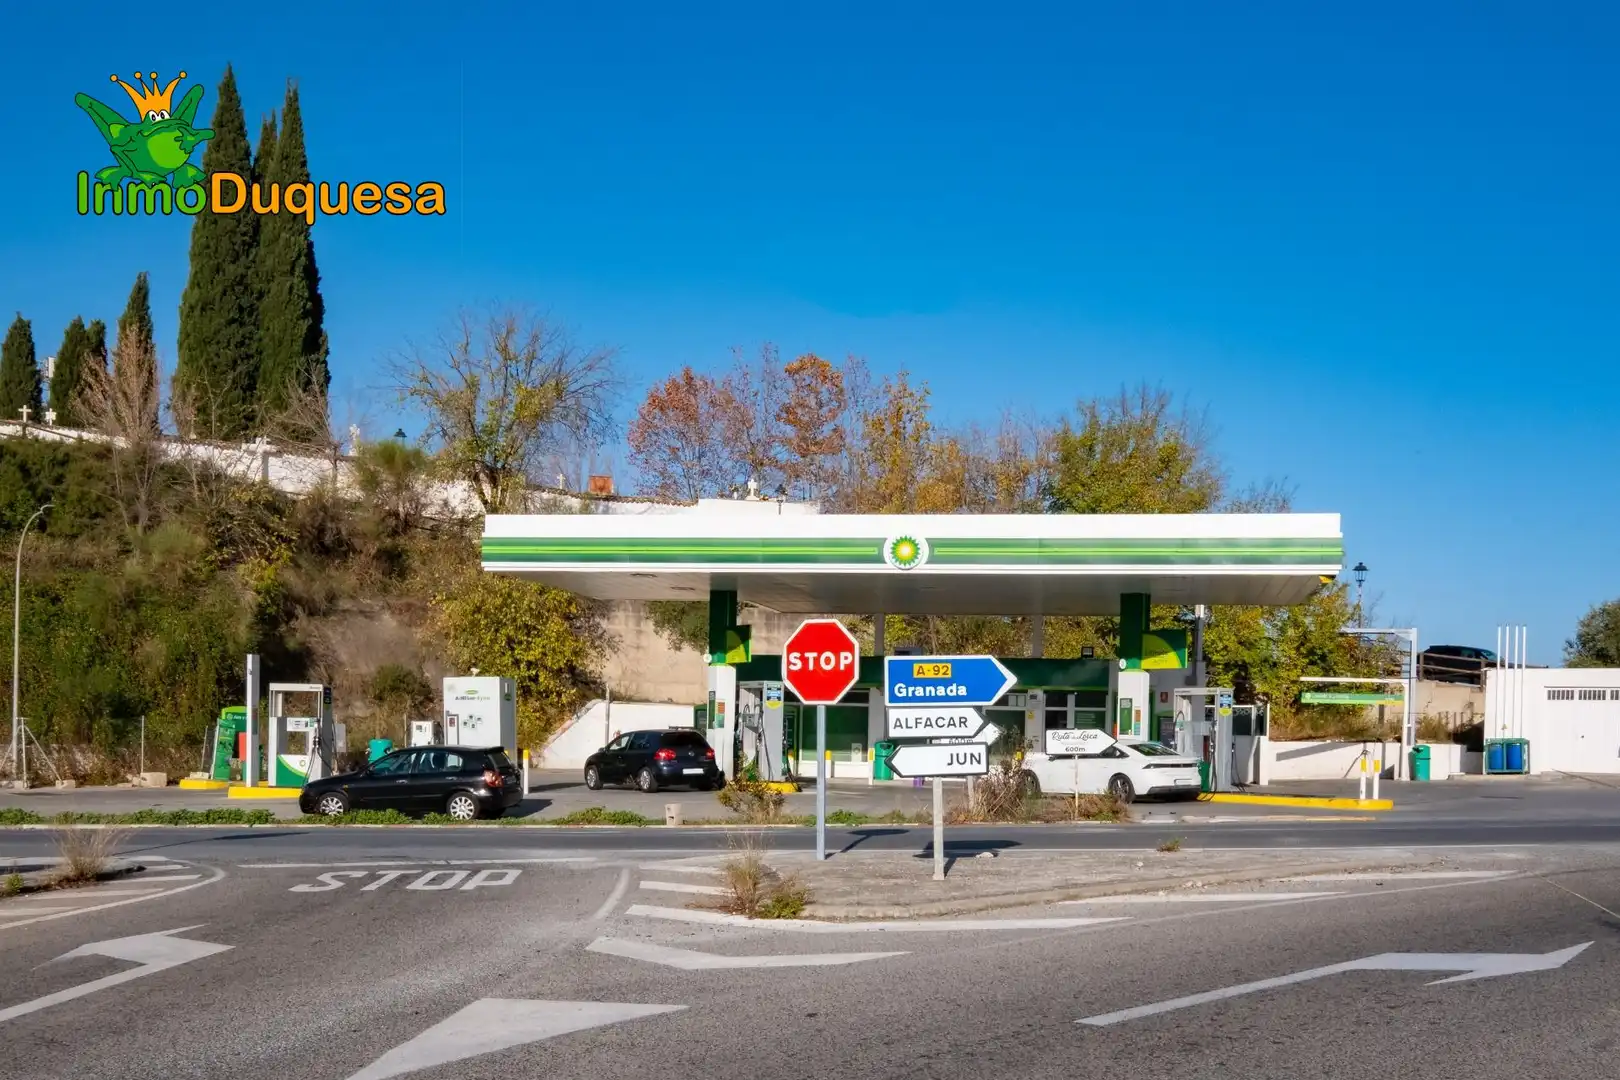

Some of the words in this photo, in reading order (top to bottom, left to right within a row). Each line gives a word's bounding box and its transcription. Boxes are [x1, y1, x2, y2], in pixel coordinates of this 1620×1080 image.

[788, 651, 853, 671] STOP
[916, 664, 950, 677] A-92
[894, 683, 967, 698] Granada
[893, 716, 968, 729] ALFACAR
[947, 752, 982, 766] JUN
[288, 869, 523, 892] STOP
